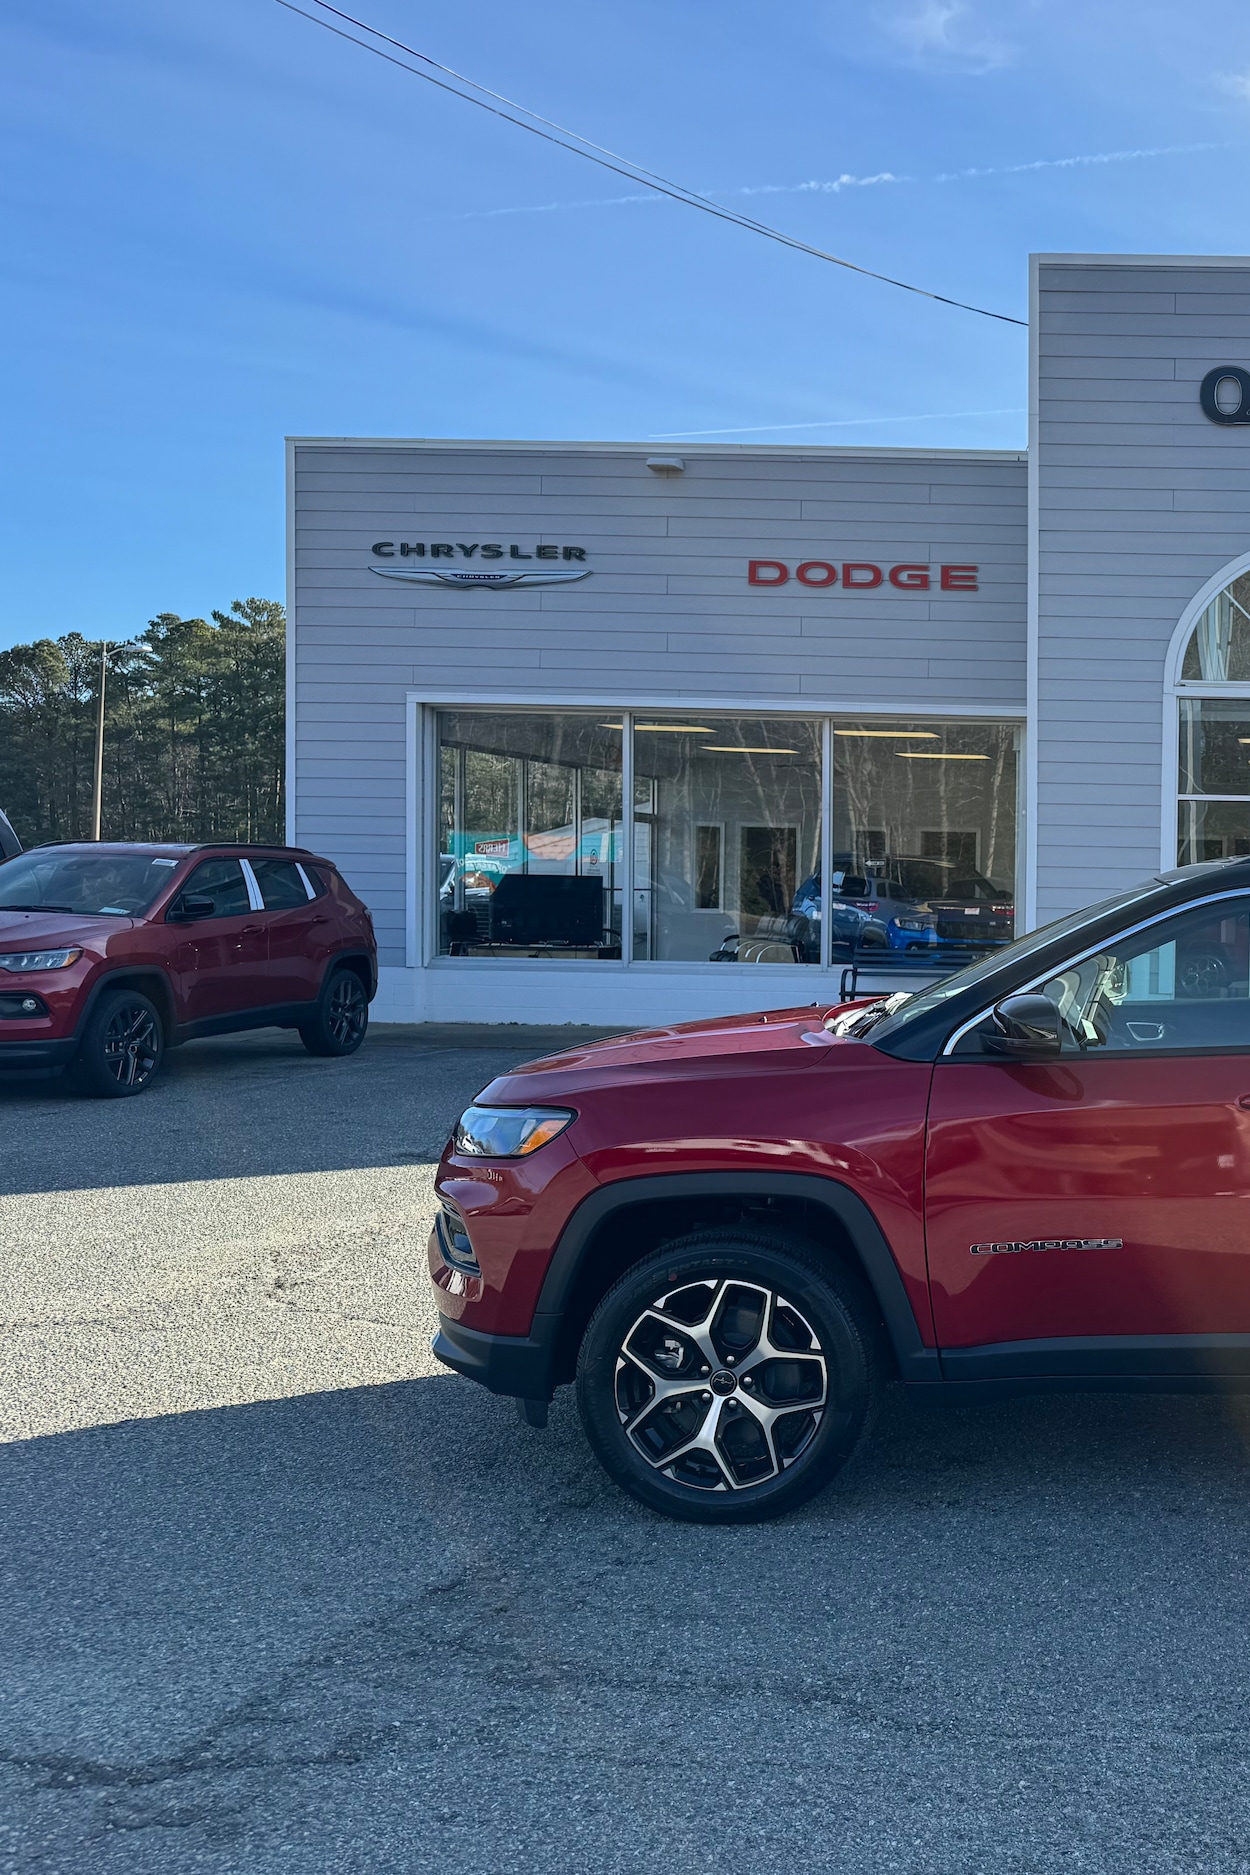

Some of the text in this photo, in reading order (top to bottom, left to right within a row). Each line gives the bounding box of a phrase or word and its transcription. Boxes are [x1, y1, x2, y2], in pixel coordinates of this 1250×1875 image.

[371, 541, 587, 561] CHRYSLER
[748, 560, 979, 592] DODGE
[969, 1238, 1124, 1255] COMPASS
